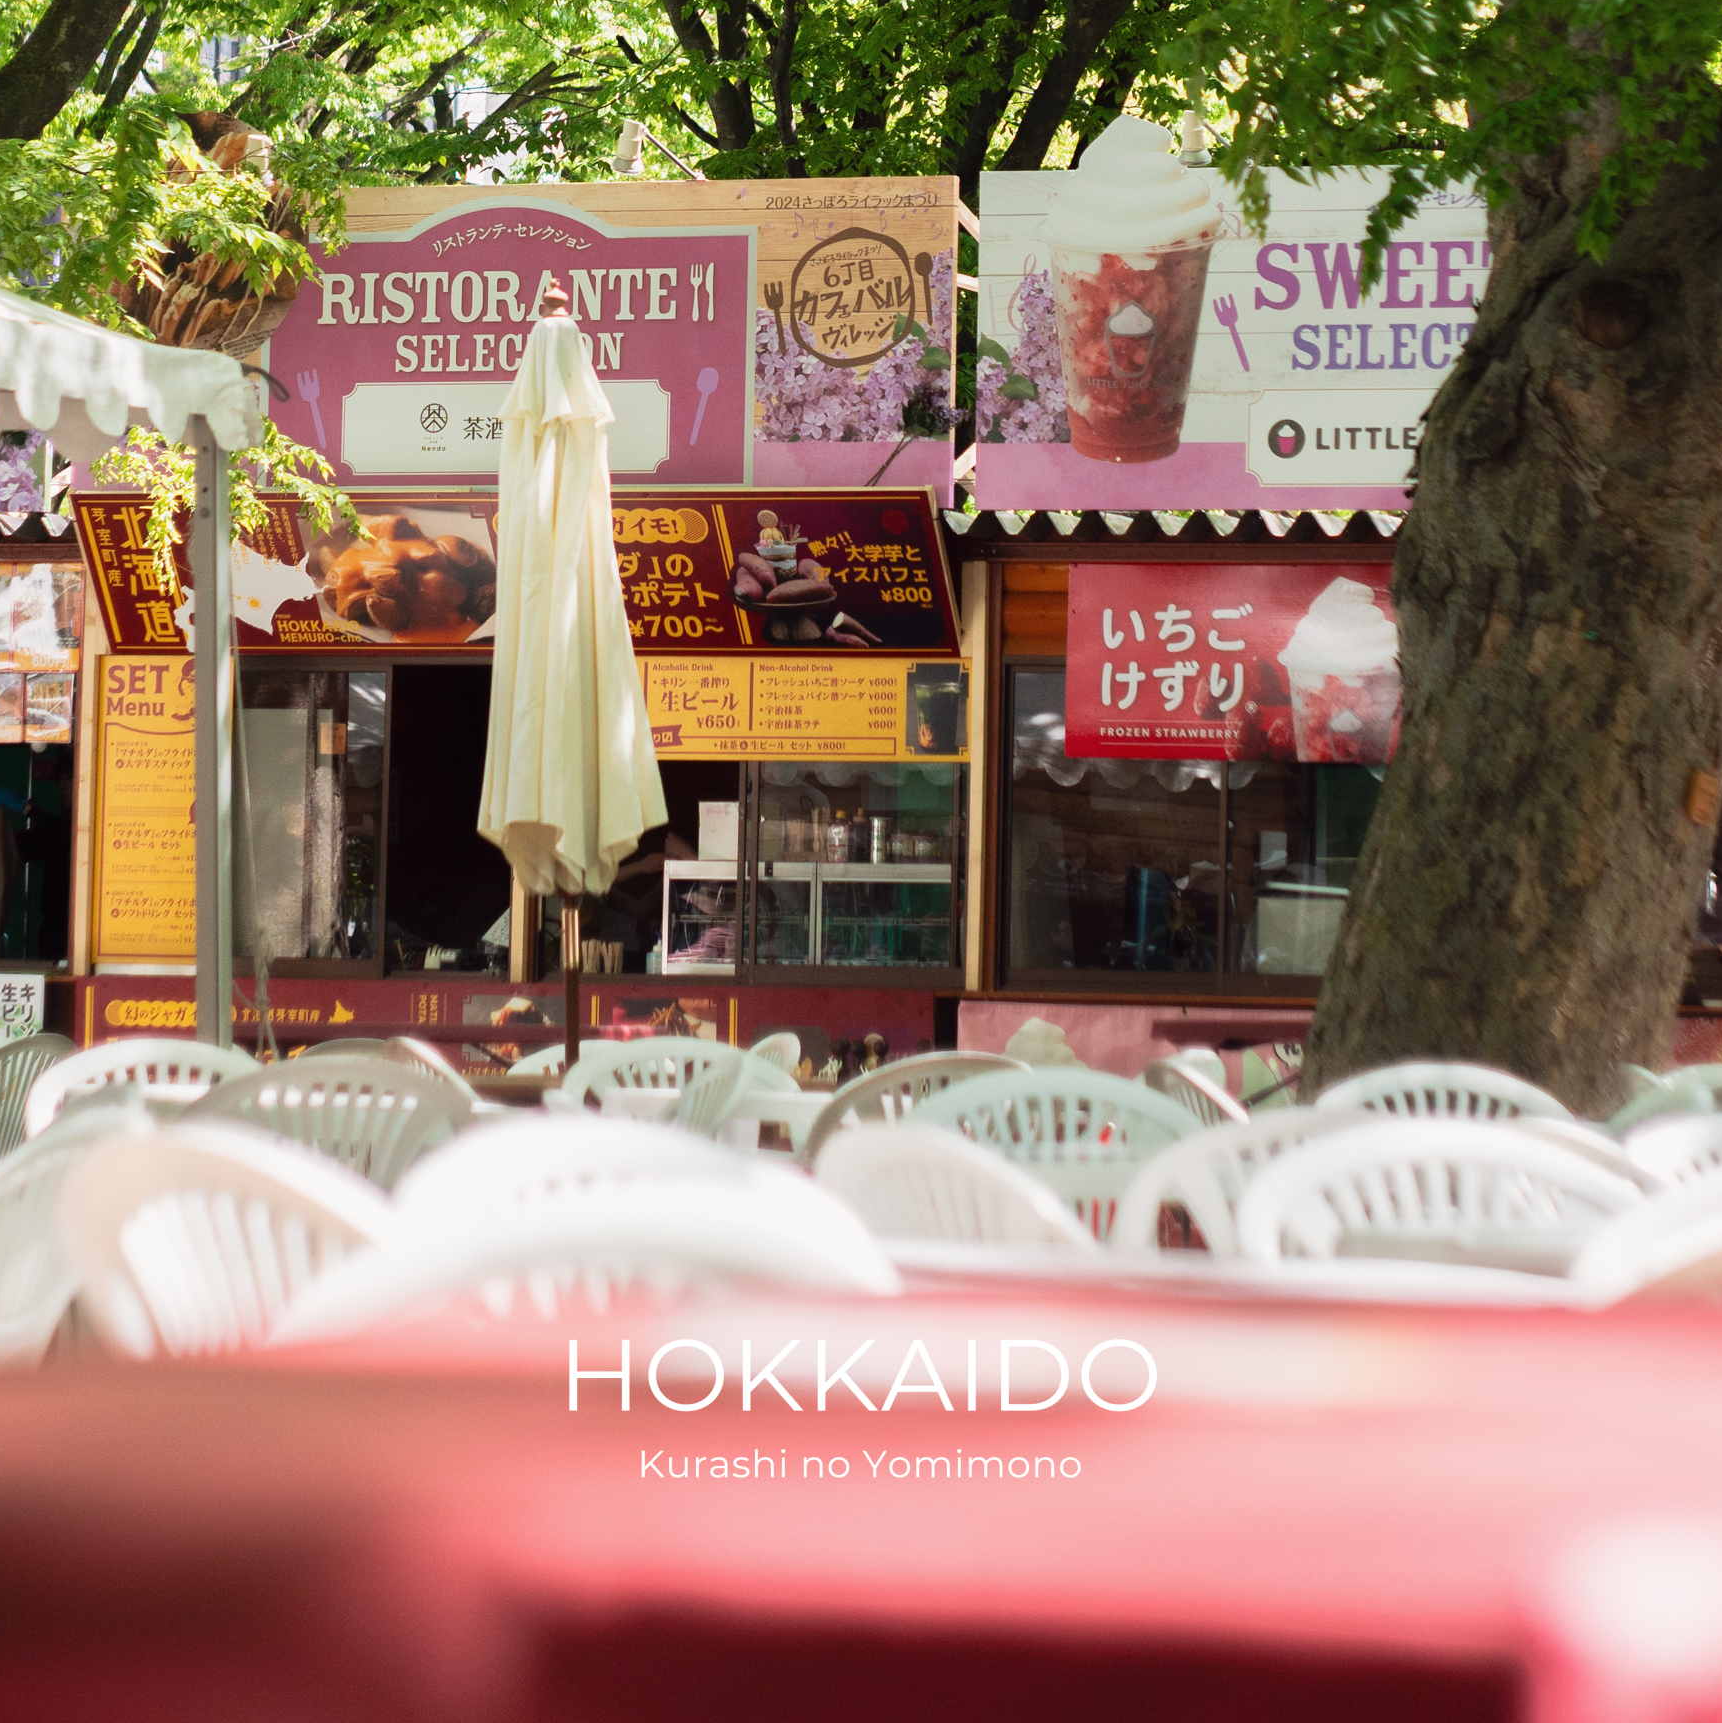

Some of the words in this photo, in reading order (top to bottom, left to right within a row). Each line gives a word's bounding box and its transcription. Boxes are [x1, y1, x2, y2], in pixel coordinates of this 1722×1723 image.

[766, 193, 938, 209] 2024さっぽろライラックまつり
[431, 222, 593, 259] リストランテ・セレクション
[823, 259, 875, 288] 6丁目
[318, 267, 678, 325] RISTORANTE
[794, 275, 913, 326] カフェバル
[821, 314, 898, 350] ヴィレッジ
[1316, 426, 1419, 451] LITTLE
[90, 507, 125, 588] 芽室町産
[844, 544, 922, 563] 大学芋と
[112, 506, 181, 643] 北海道
[814, 565, 929, 583] アイスパフェ
[880, 586, 933, 603] ¥800
[276, 619, 361, 633] HOKKAIDO
[1102, 603, 1254, 653] いちご
[280, 632, 363, 643] MEMURO-cho
[652, 663, 690, 672] Alcoholic
[691, 663, 714, 671] Drink
[759, 664, 809, 672] Non-Alcohol
[811, 663, 834, 672] Drink
[107, 663, 170, 695] SET
[660, 677, 730, 689] キリン一番搾り
[766, 677, 866, 687] フレッシュいちご酢ソーダ
[868, 677, 894, 687] ¥600
[660, 690, 740, 712] 生ビール
[868, 691, 894, 701] ¥600
[105, 696, 165, 717] Menu
[765, 705, 803, 716] 宇治抹茶
[868, 706, 894, 715] ¥600
[696, 714, 736, 729] ¥650
[764, 719, 820, 730] 宇治抹茶ラテ
[867, 720, 894, 729] ¥600
[1099, 726, 1151, 738] FROZEN
[1155, 728, 1241, 739] STRAWBERRY
[115, 748, 195, 758] 「マチルダ」のフライド
[789, 741, 812, 750] セット
[817, 741, 843, 751] ¥800
[160, 840, 181, 849] セット
[175, 909, 196, 918] セット
